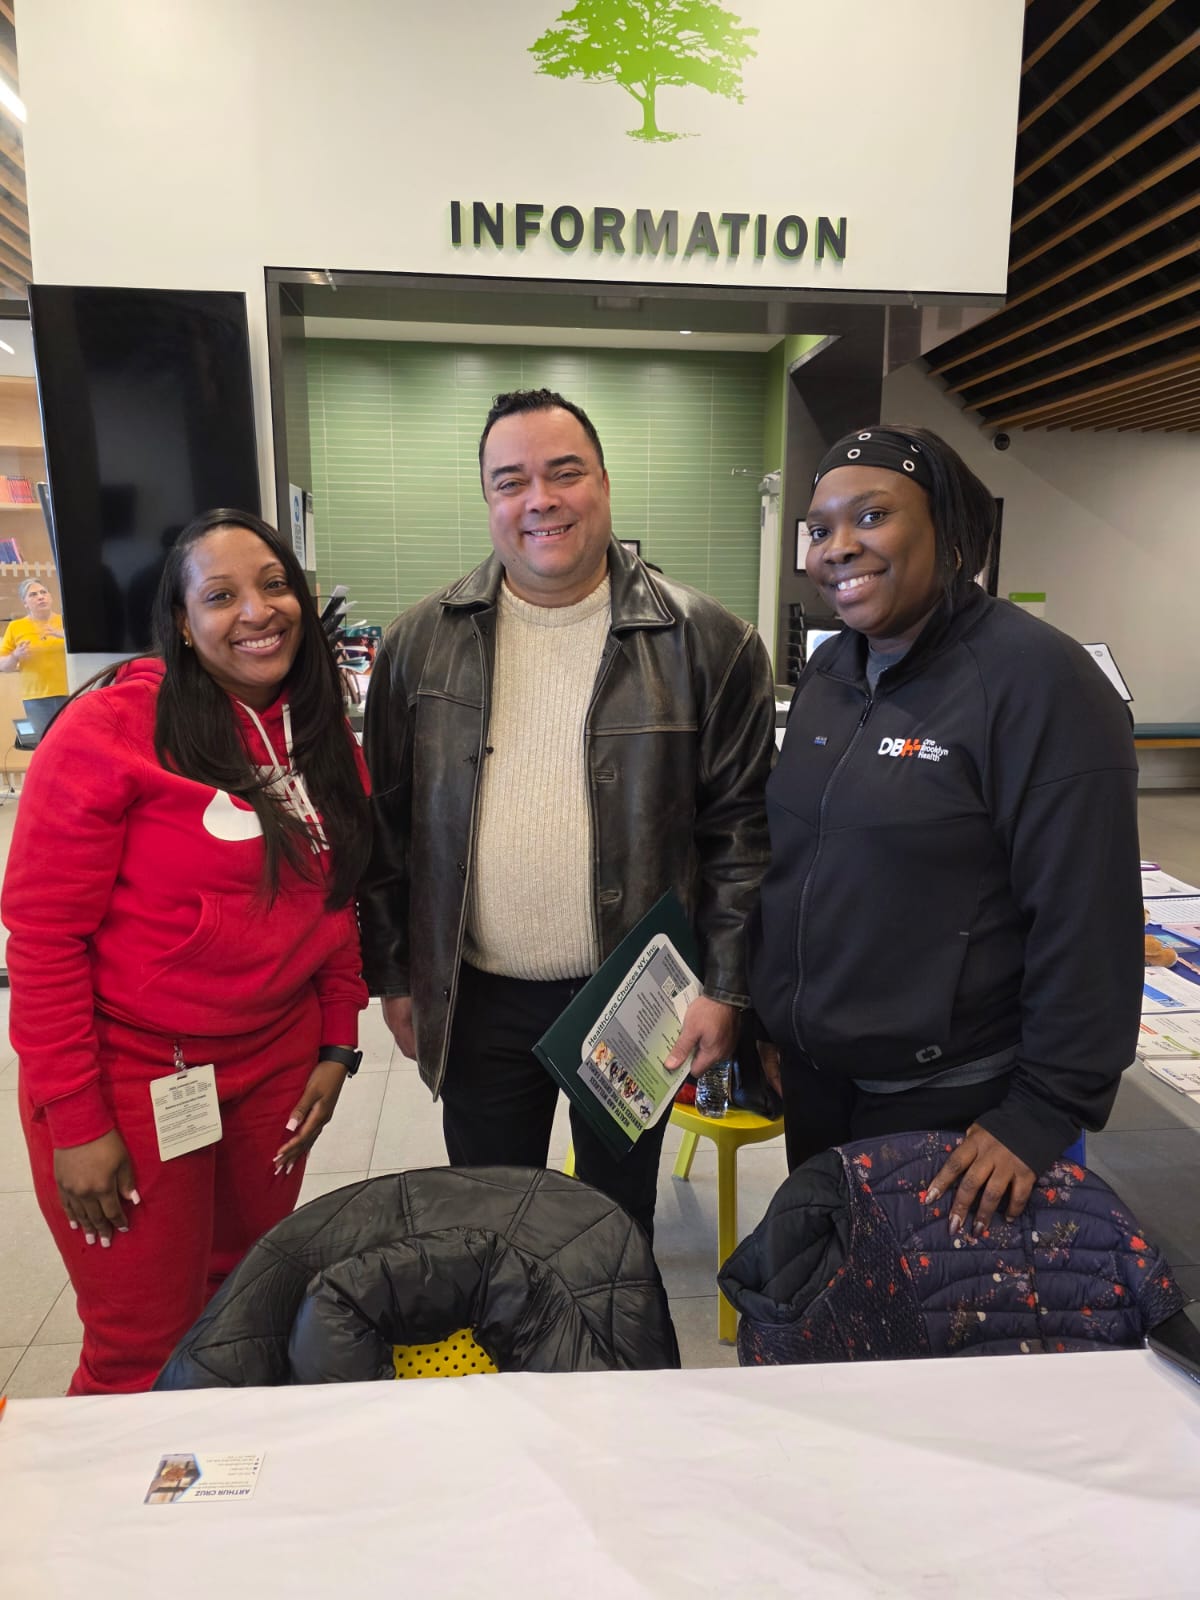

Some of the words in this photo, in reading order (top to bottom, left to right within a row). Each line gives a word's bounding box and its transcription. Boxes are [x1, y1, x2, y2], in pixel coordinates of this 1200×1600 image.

[450, 200, 847, 260] INFORMATION
[588, 1003, 618, 1047] HealthCare
[616, 970, 639, 1002] Choices
